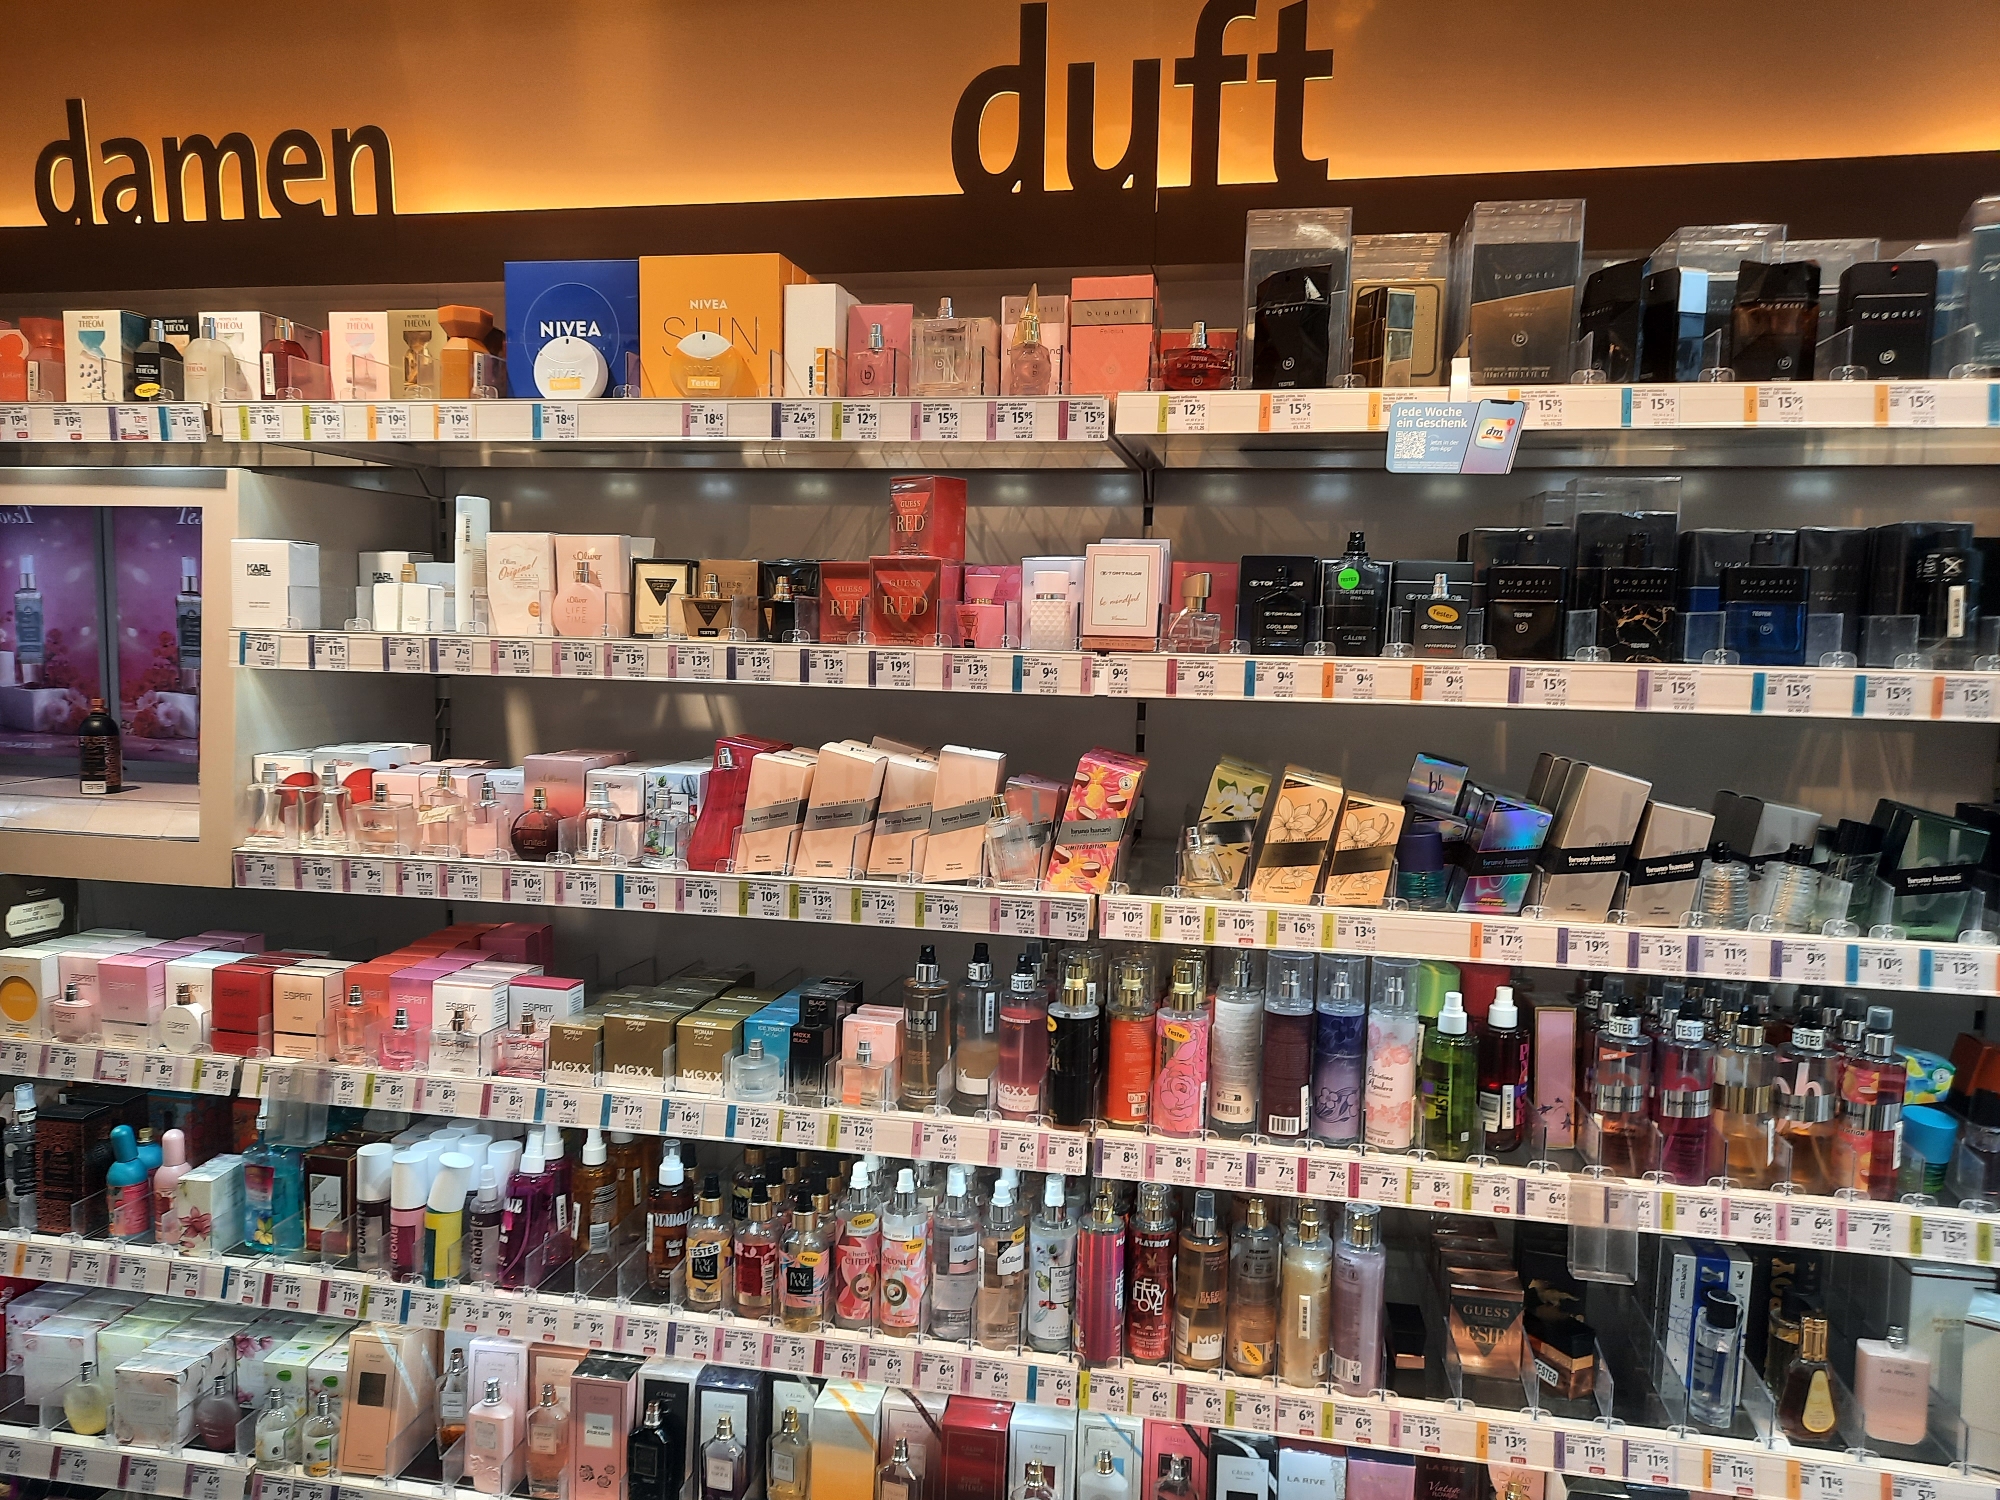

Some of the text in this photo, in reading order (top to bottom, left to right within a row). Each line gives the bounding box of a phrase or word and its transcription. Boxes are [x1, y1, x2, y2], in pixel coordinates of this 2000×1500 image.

[952, 0, 1334, 194] duft
[35, 98, 396, 226] damen
[1494, 271, 1555, 281] bugatti
[689, 299, 728, 310] NIVEA
[1265, 306, 1303, 317] bugatti
[1861, 310, 1921, 320] bugatti
[540, 320, 601, 338] NIVEA
[690, 379, 718, 387] Tester
[1397, 406, 1463, 417] Jede Woche
[1396, 417, 1468, 428] ein Geschenk
[1485, 426, 1504, 437] dm
[900, 500, 921, 508] GUESS
[896, 515, 925, 532] RED
[889, 579, 922, 587] GUESS
[1499, 578, 1552, 587] bugatti
[1613, 578, 1667, 587] bugatti
[1740, 578, 1797, 587] bugatti
[566, 606, 586, 614] LIFE
[882, 596, 929, 616] RED
[1432, 608, 1453, 619] Tester
[1428, 771, 1444, 794] bb
[751, 814, 768, 822] bruno
[1070, 827, 1089, 835] bruno
[523, 838, 547, 847] united
[70, 973, 97, 982] ESPRIT
[109, 981, 137, 990] ESPRIT
[283, 991, 313, 1002] ESPRIT
[396, 993, 428, 1005] ESPRIT
[445, 1001, 476, 1013] ESPRIT
[522, 1002, 553, 1013] ESPRIT
[54, 1010, 77, 1019] ESPRIT
[167, 1020, 191, 1030] ESPRIT
[1167, 1027, 1186, 1040] Tester
[509, 1042, 538, 1051] ESPRIT
[1436, 1077, 1450, 1117] TESTER
[854, 1217, 872, 1225] Tester
[906, 1242, 923, 1250] Tester
[1134, 1237, 1170, 1248] PLAYBOY
[689, 1244, 720, 1257] TESTER
[1463, 1304, 1510, 1319] GUESS
[1244, 1345, 1260, 1363] Tester
[1425, 1463, 1466, 1474] LA RIVE
[1286, 1475, 1326, 1486] LA RIVE
[1428, 1480, 1461, 1494] Vintage
